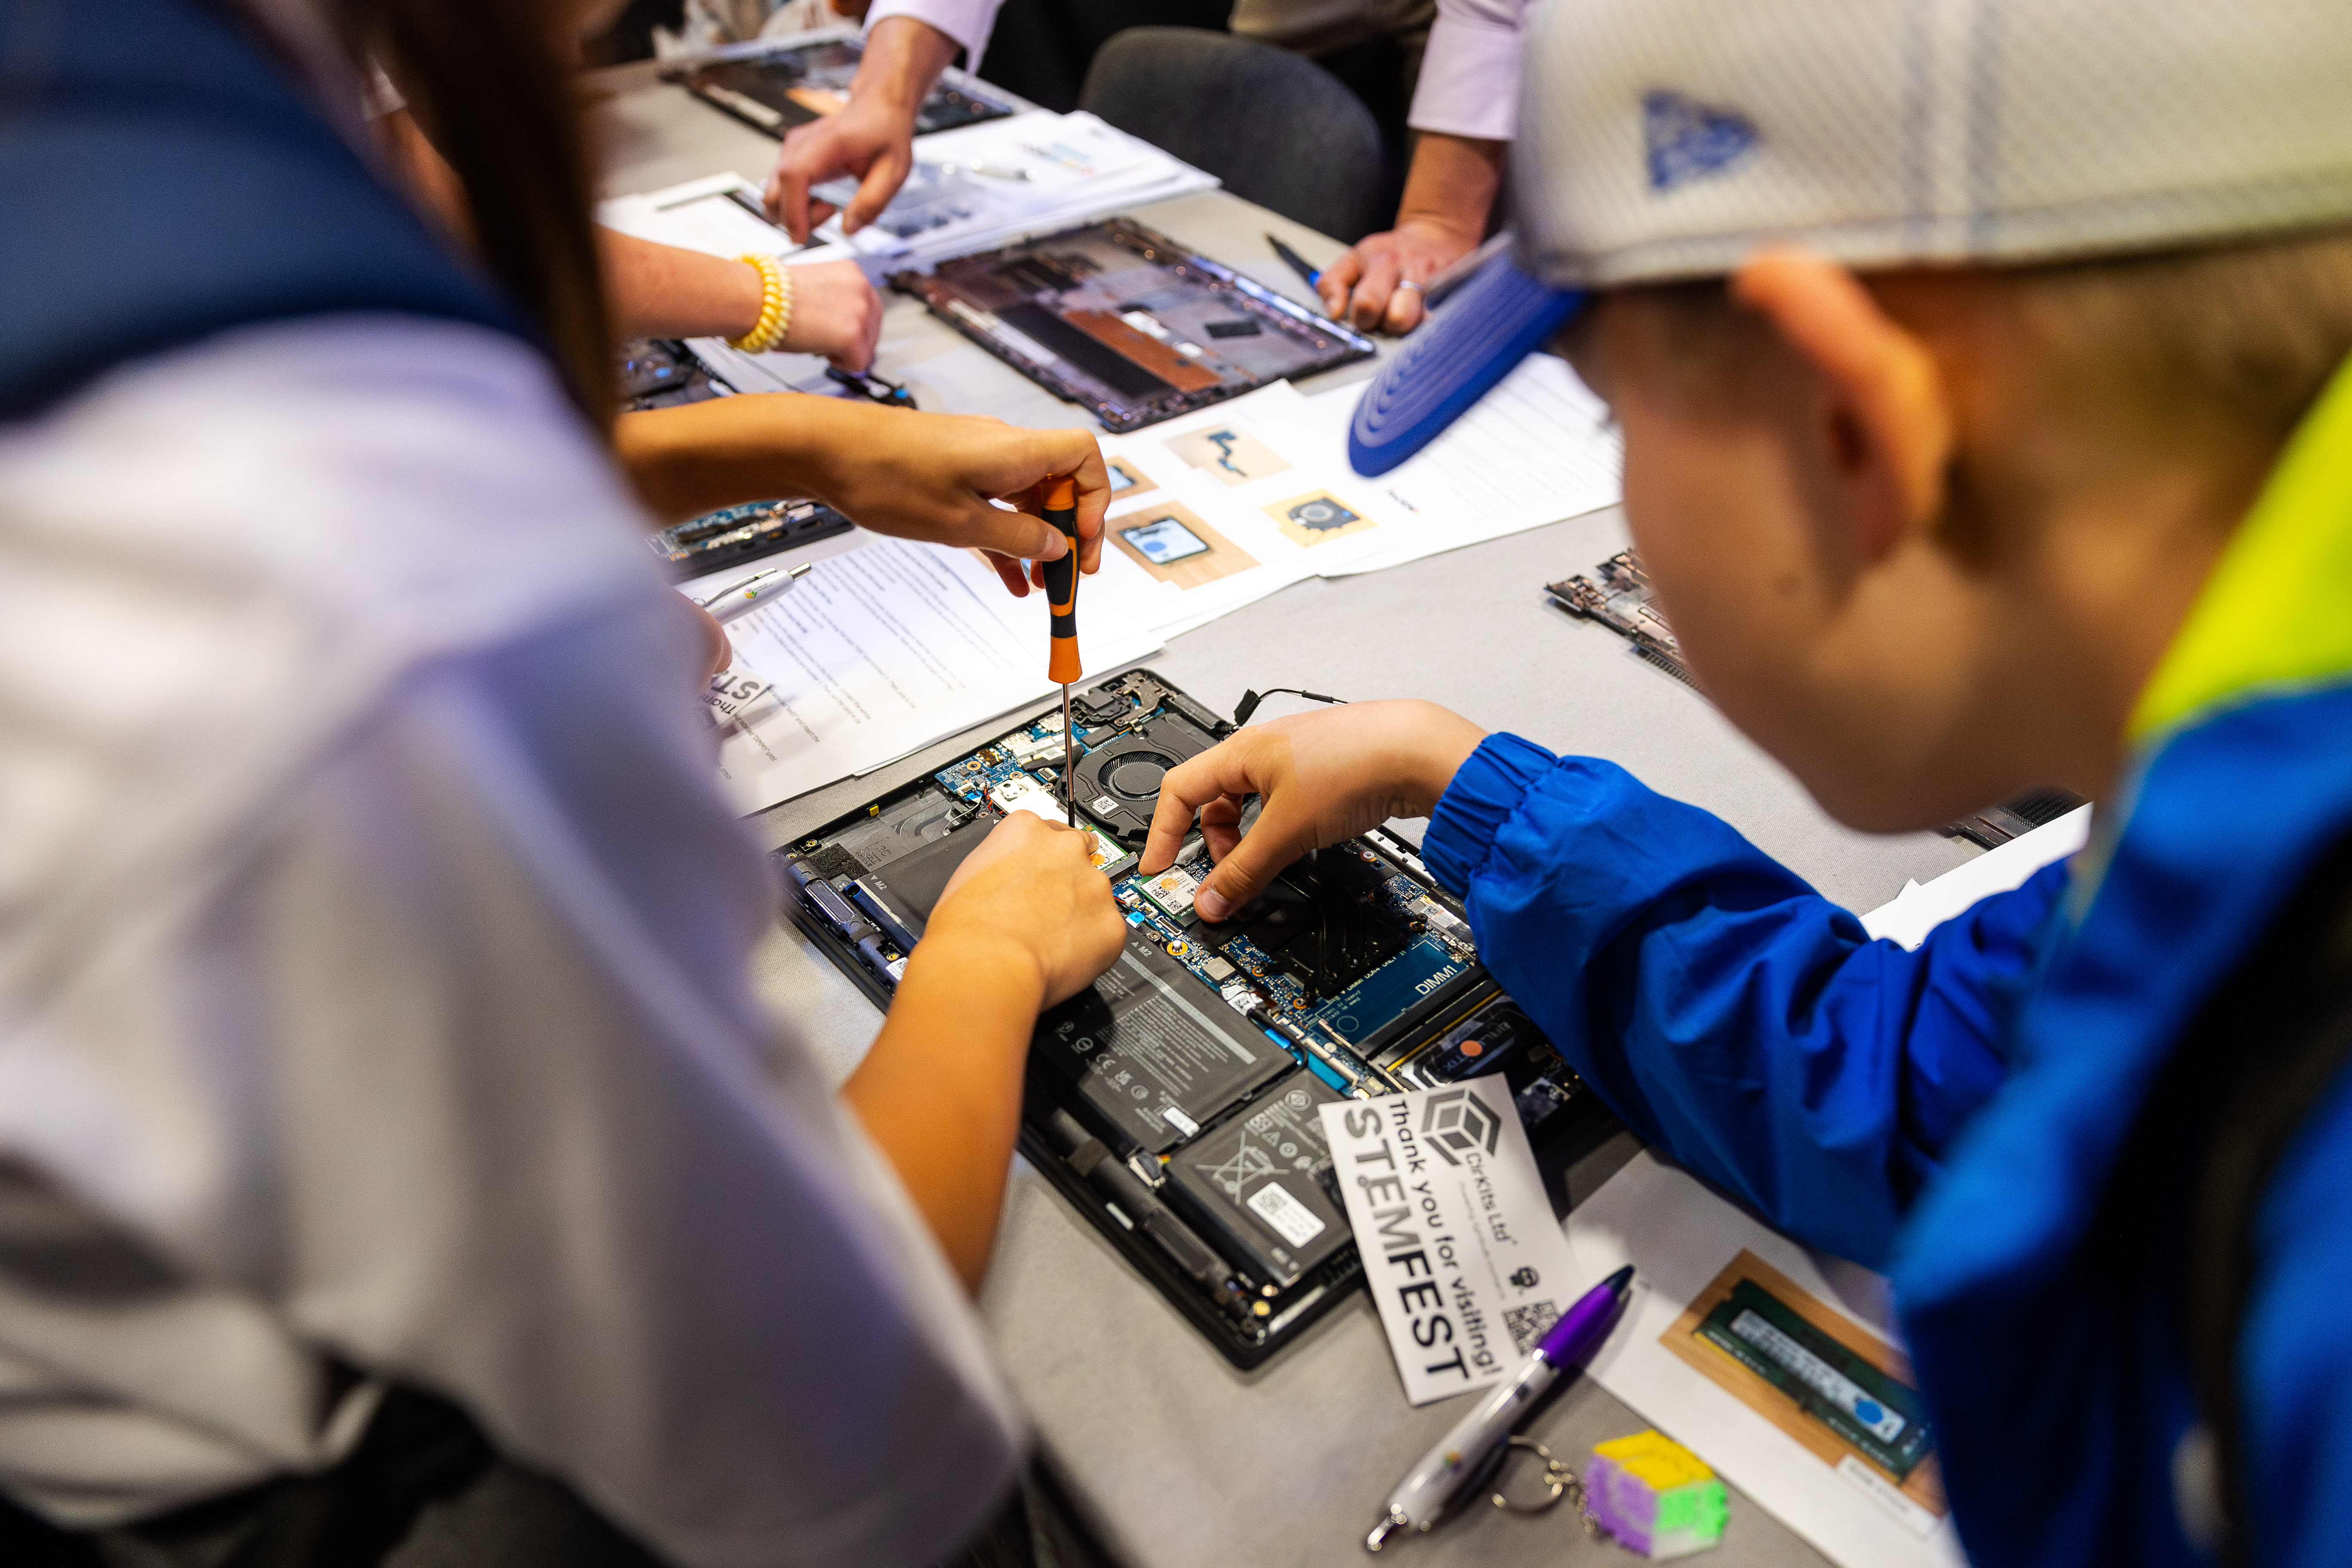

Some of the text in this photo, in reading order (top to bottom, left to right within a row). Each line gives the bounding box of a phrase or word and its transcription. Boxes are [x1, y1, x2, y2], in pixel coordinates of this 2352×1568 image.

[766, 750, 777, 761] until
[874, 880, 887, 891] M2
[1138, 946, 1152, 958] M2
[1414, 964, 1458, 995] DIMM1
[1345, 1106, 1472, 1381] STEMFEST
[1389, 1099, 1503, 1375] Thank you for visiting!
